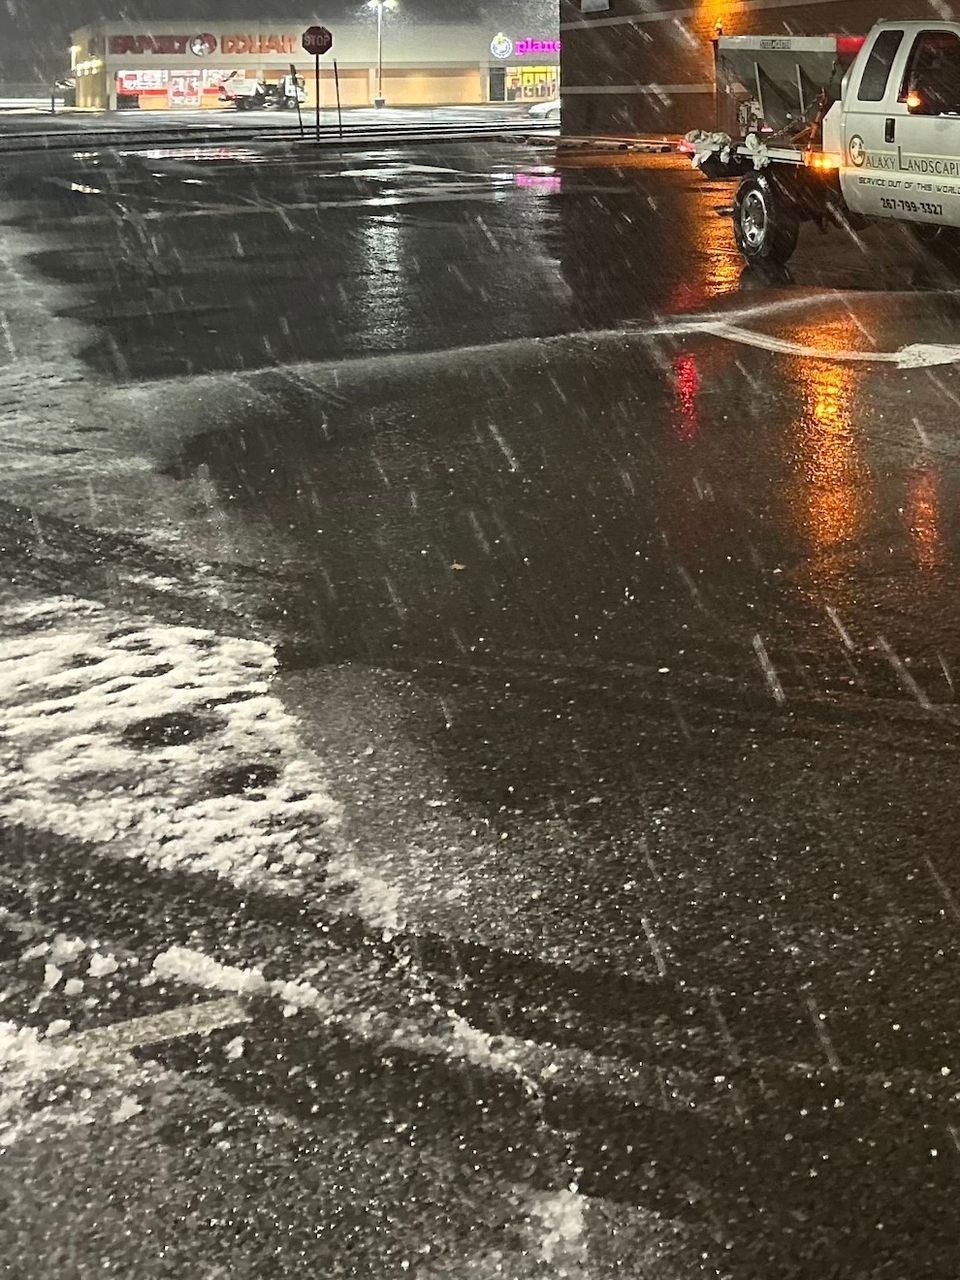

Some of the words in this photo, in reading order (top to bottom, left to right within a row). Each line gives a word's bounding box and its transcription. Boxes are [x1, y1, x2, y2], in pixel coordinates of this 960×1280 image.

[304, 35, 331, 46] STOP
[849, 134, 896, 169] GALAXY
[858, 177, 885, 186] SERVICE
[888, 180, 902, 189] OUT
[904, 181, 914, 189] OF
[917, 182, 933, 192] THIS
[880, 198, 943, 216] 267-799-3327
